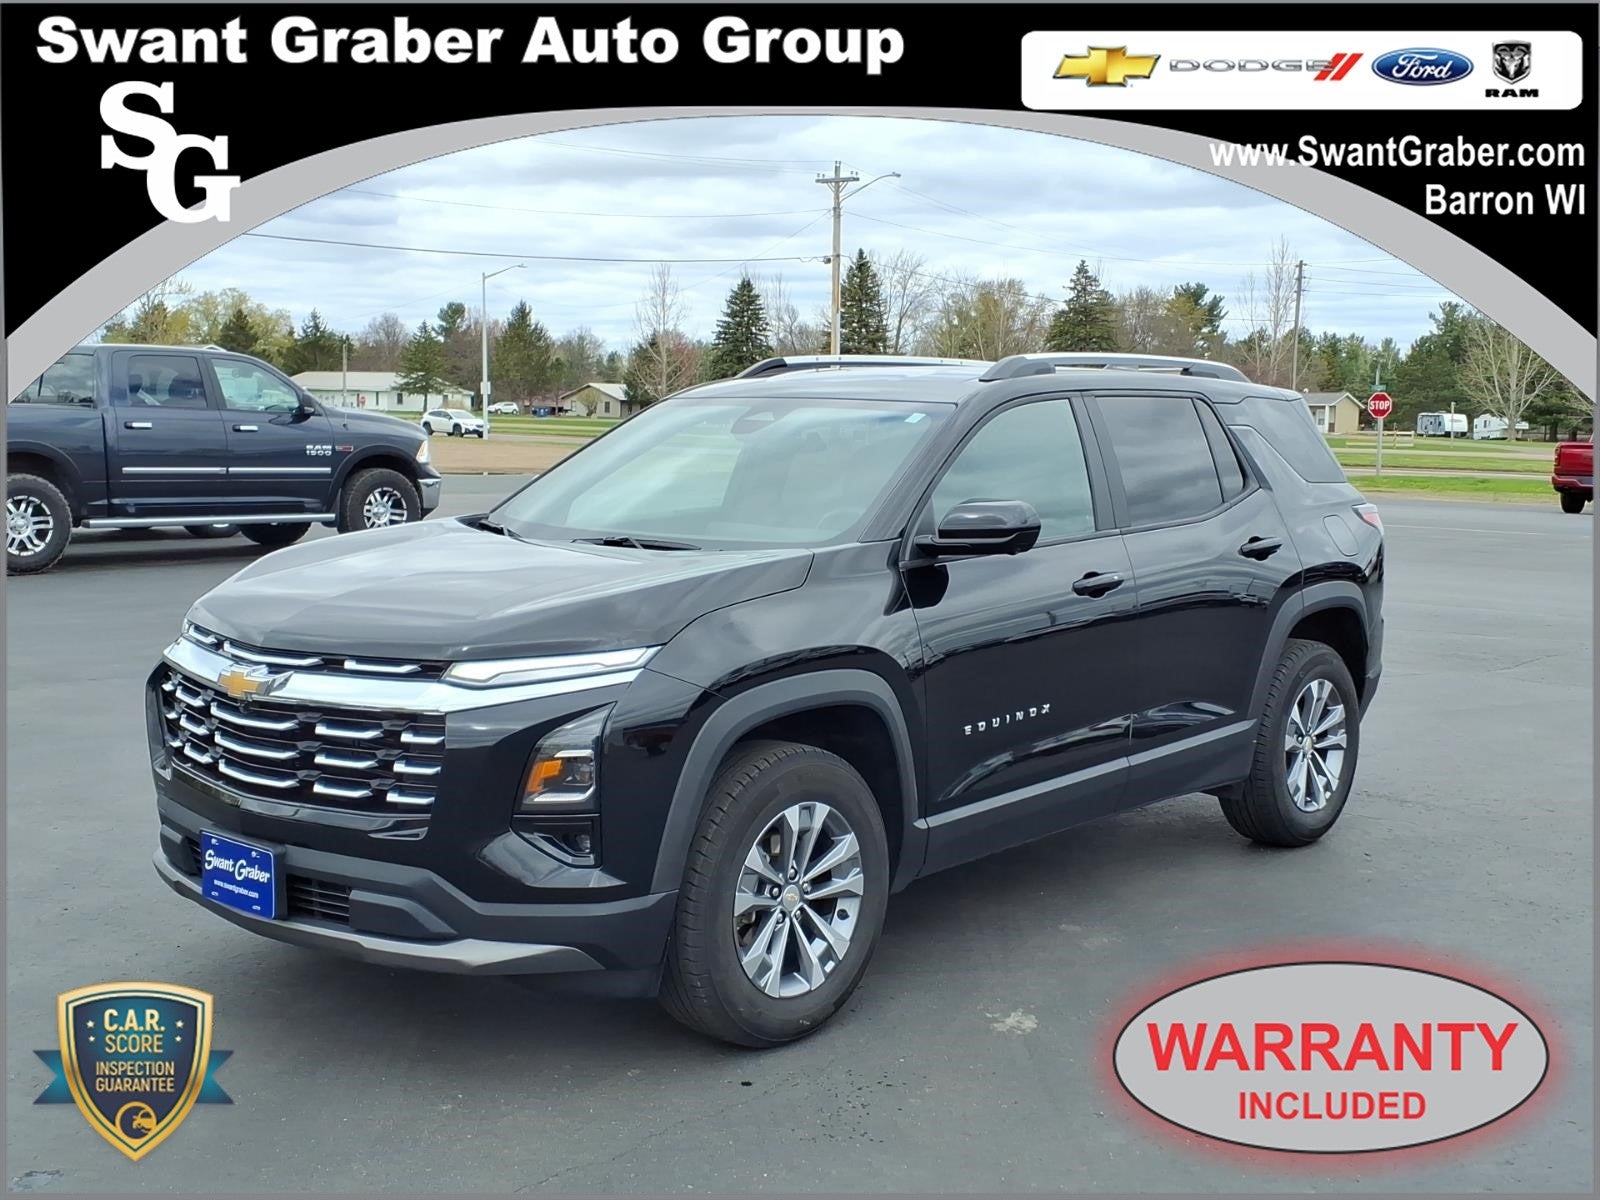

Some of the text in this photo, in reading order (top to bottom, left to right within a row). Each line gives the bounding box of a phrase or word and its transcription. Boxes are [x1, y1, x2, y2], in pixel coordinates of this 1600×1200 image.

[1369, 400, 1390, 410] STOP
[963, 703, 1050, 735] EQUINOX
[204, 849, 270, 883] Swant Graber
